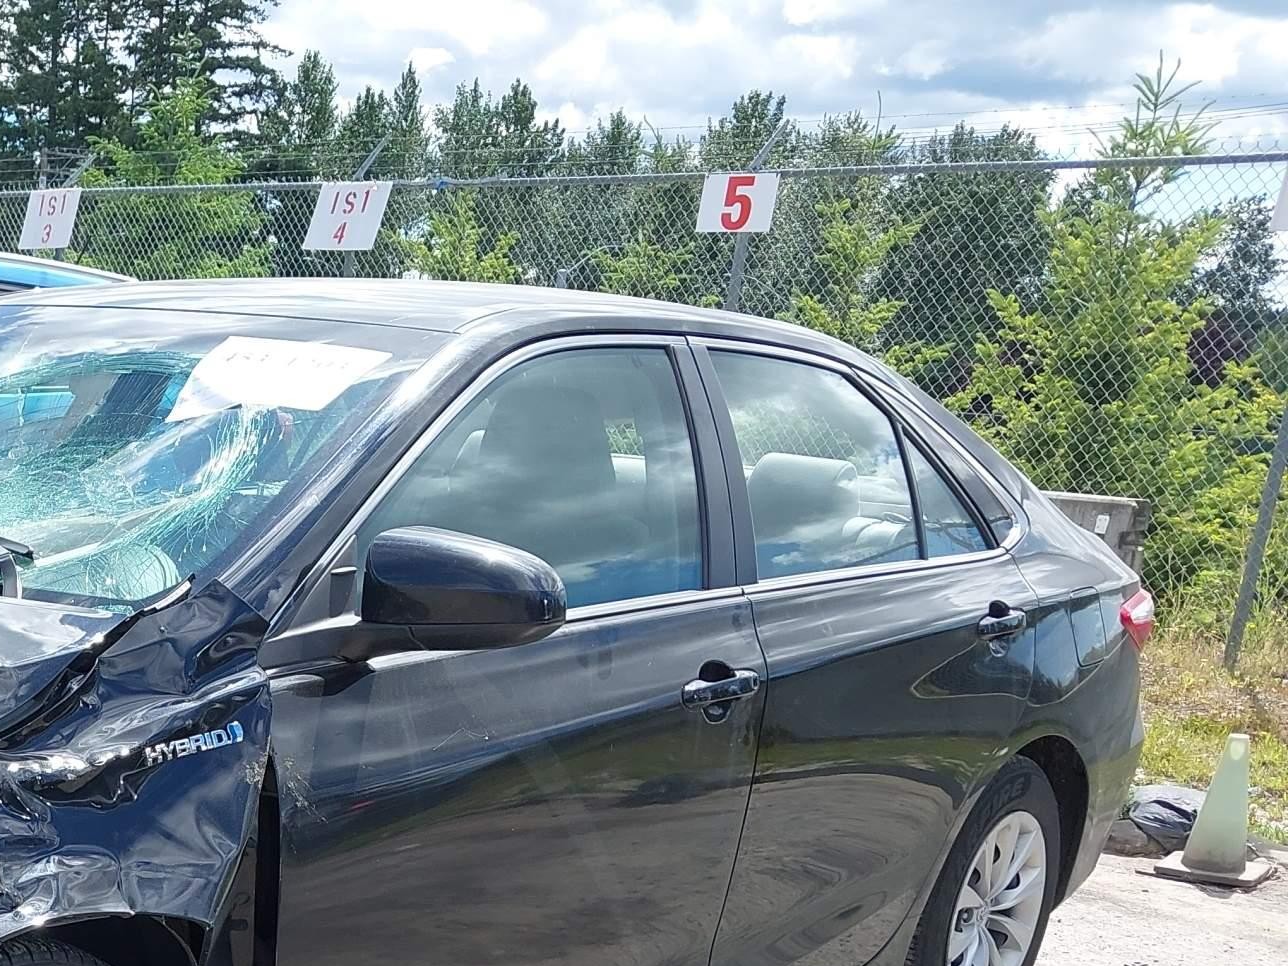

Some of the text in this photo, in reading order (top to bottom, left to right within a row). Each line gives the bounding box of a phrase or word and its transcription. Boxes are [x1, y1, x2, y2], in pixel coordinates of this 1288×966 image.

[720, 175, 756, 231] 5
[41, 223, 53, 244] 3
[332, 221, 348, 245] 4
[144, 728, 231, 767] HYBRID
